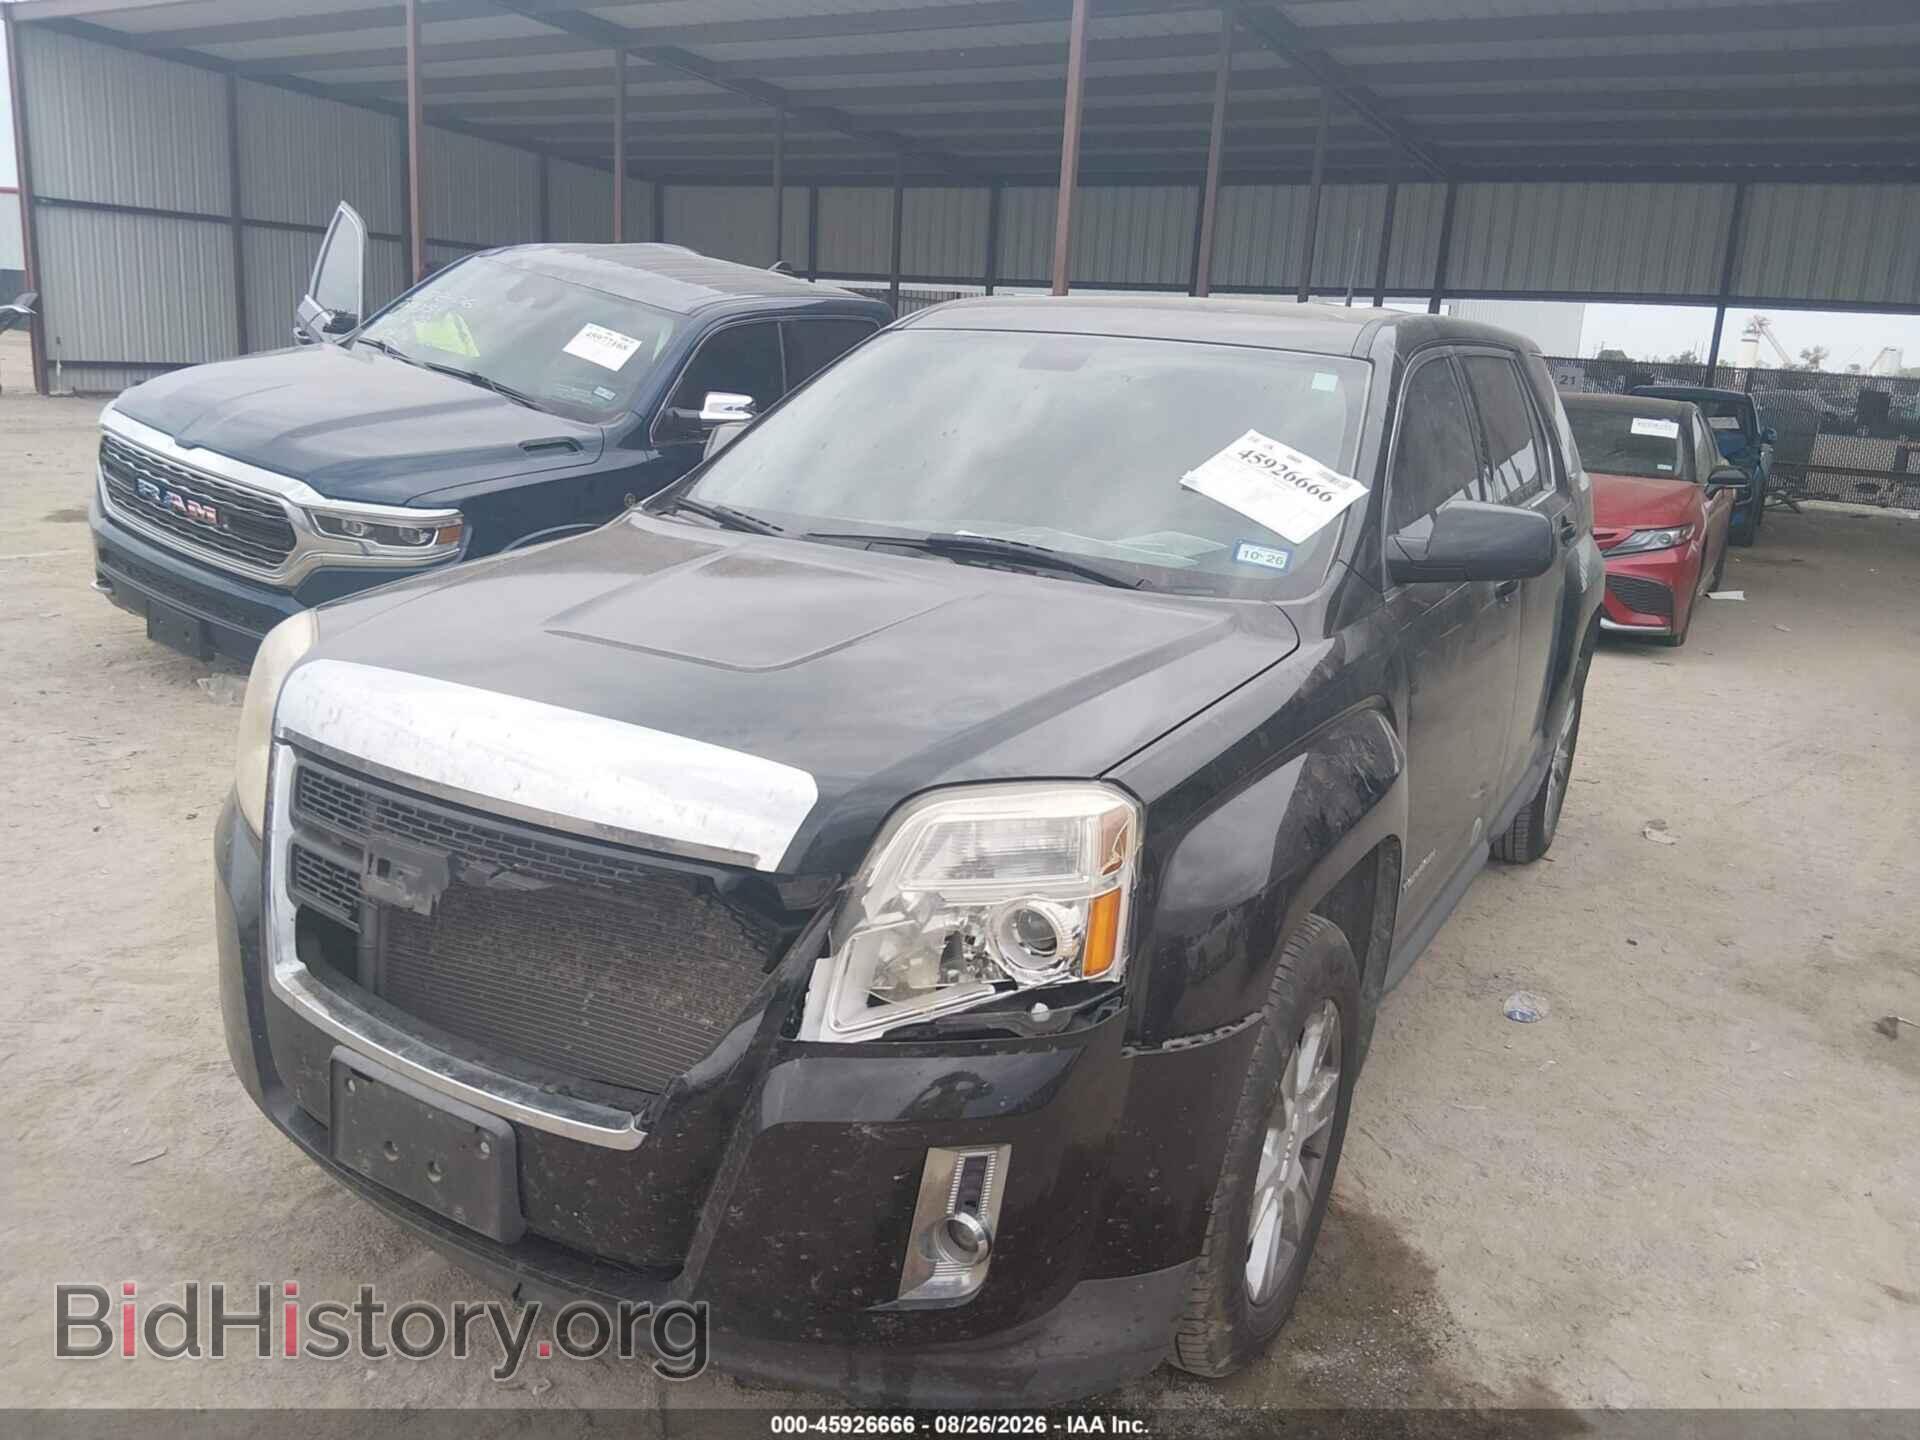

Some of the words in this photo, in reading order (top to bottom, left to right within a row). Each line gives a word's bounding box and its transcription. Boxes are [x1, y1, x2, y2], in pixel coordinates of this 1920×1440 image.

[1559, 374, 1576, 385] 21
[1238, 450, 1333, 502] 45926666
[136, 477, 219, 525] RAM
